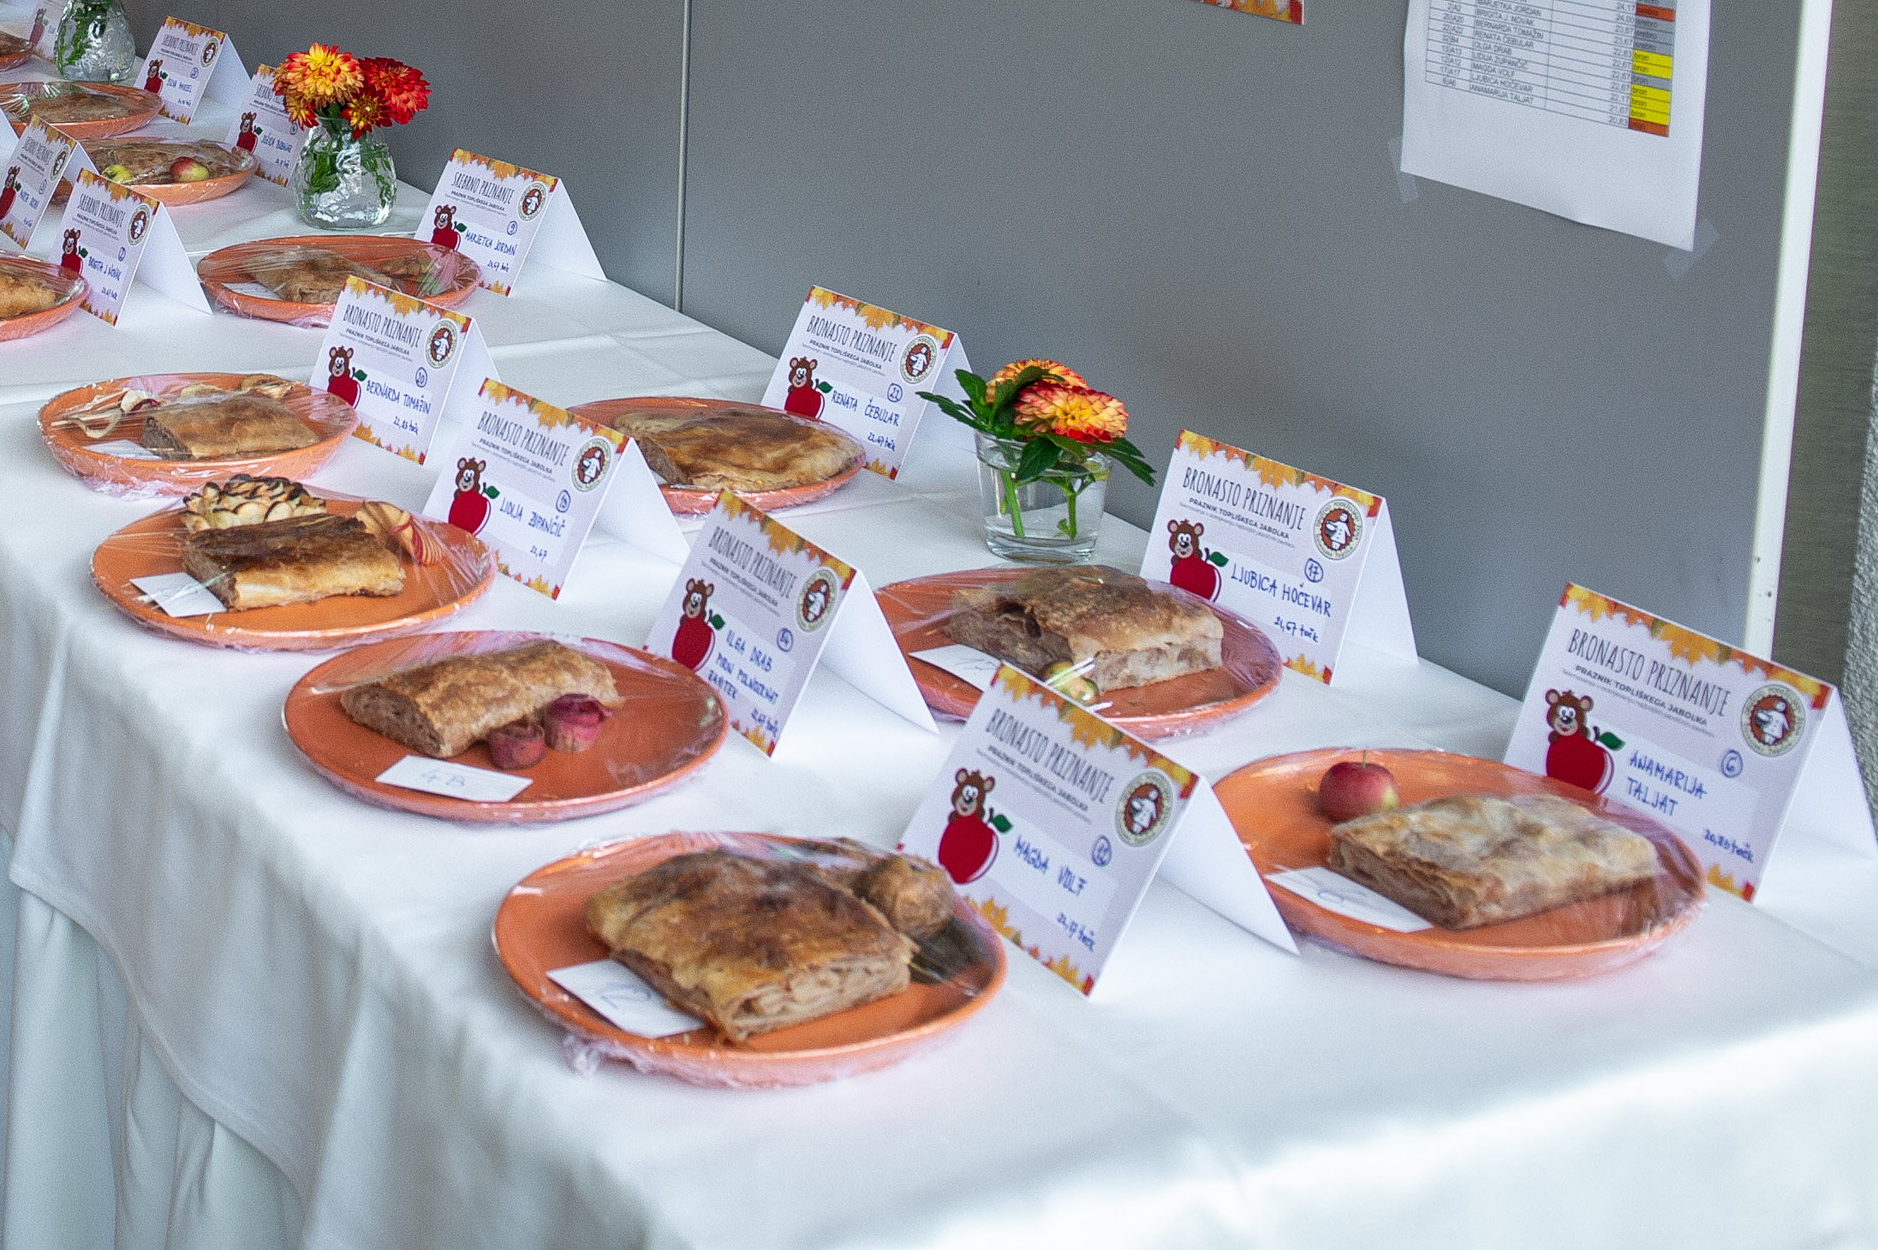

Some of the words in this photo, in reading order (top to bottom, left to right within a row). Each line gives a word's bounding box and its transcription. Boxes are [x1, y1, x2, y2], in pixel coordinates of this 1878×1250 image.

[450, 171, 480, 193] SREBRNO
[478, 180, 514, 204] PRIZNANJE
[464, 230, 493, 248] MARJETKA
[493, 239, 517, 256] JORDAN
[342, 303, 381, 332] BRONASTO
[380, 317, 422, 347] PRIZNANJE
[806, 315, 851, 345] BRONASTO
[849, 330, 897, 362] PRIZNANJE
[365, 379, 400, 403] BERNARDA
[403, 393, 431, 414] TOMAŽIN
[831, 390, 858, 411] RENATA
[864, 397, 899, 426] ČEBULAR
[476, 411, 522, 445] BRONASTO
[520, 429, 569, 466] PRIZNANJE
[1182, 466, 1241, 506] BRONASTO
[1242, 488, 1305, 530] PRIZNANJE
[1188, 497, 1217, 512] PRAZNIK
[1218, 507, 1258, 527] TOPLIŠKEGA
[1259, 523, 1289, 539] JABOLKA
[1230, 563, 1277, 596] LJUBICA
[1281, 583, 1331, 617] HOČEVAR
[1568, 628, 1644, 680] BRONASTO
[1646, 660, 1730, 716] PRIZNANJE
[1575, 664, 1612, 685] PRAZNIK
[1614, 680, 1666, 708] TOPLIŠKEGA
[1667, 704, 1707, 726] JABOLKA
[985, 708, 1048, 762] BRONASTO
[1044, 743, 1113, 803] PRIZNANJE
[1629, 751, 1706, 798] ANAMARIJA
[1627, 776, 1678, 815] TALJAT
[1014, 836, 1049, 873] MAGDA
